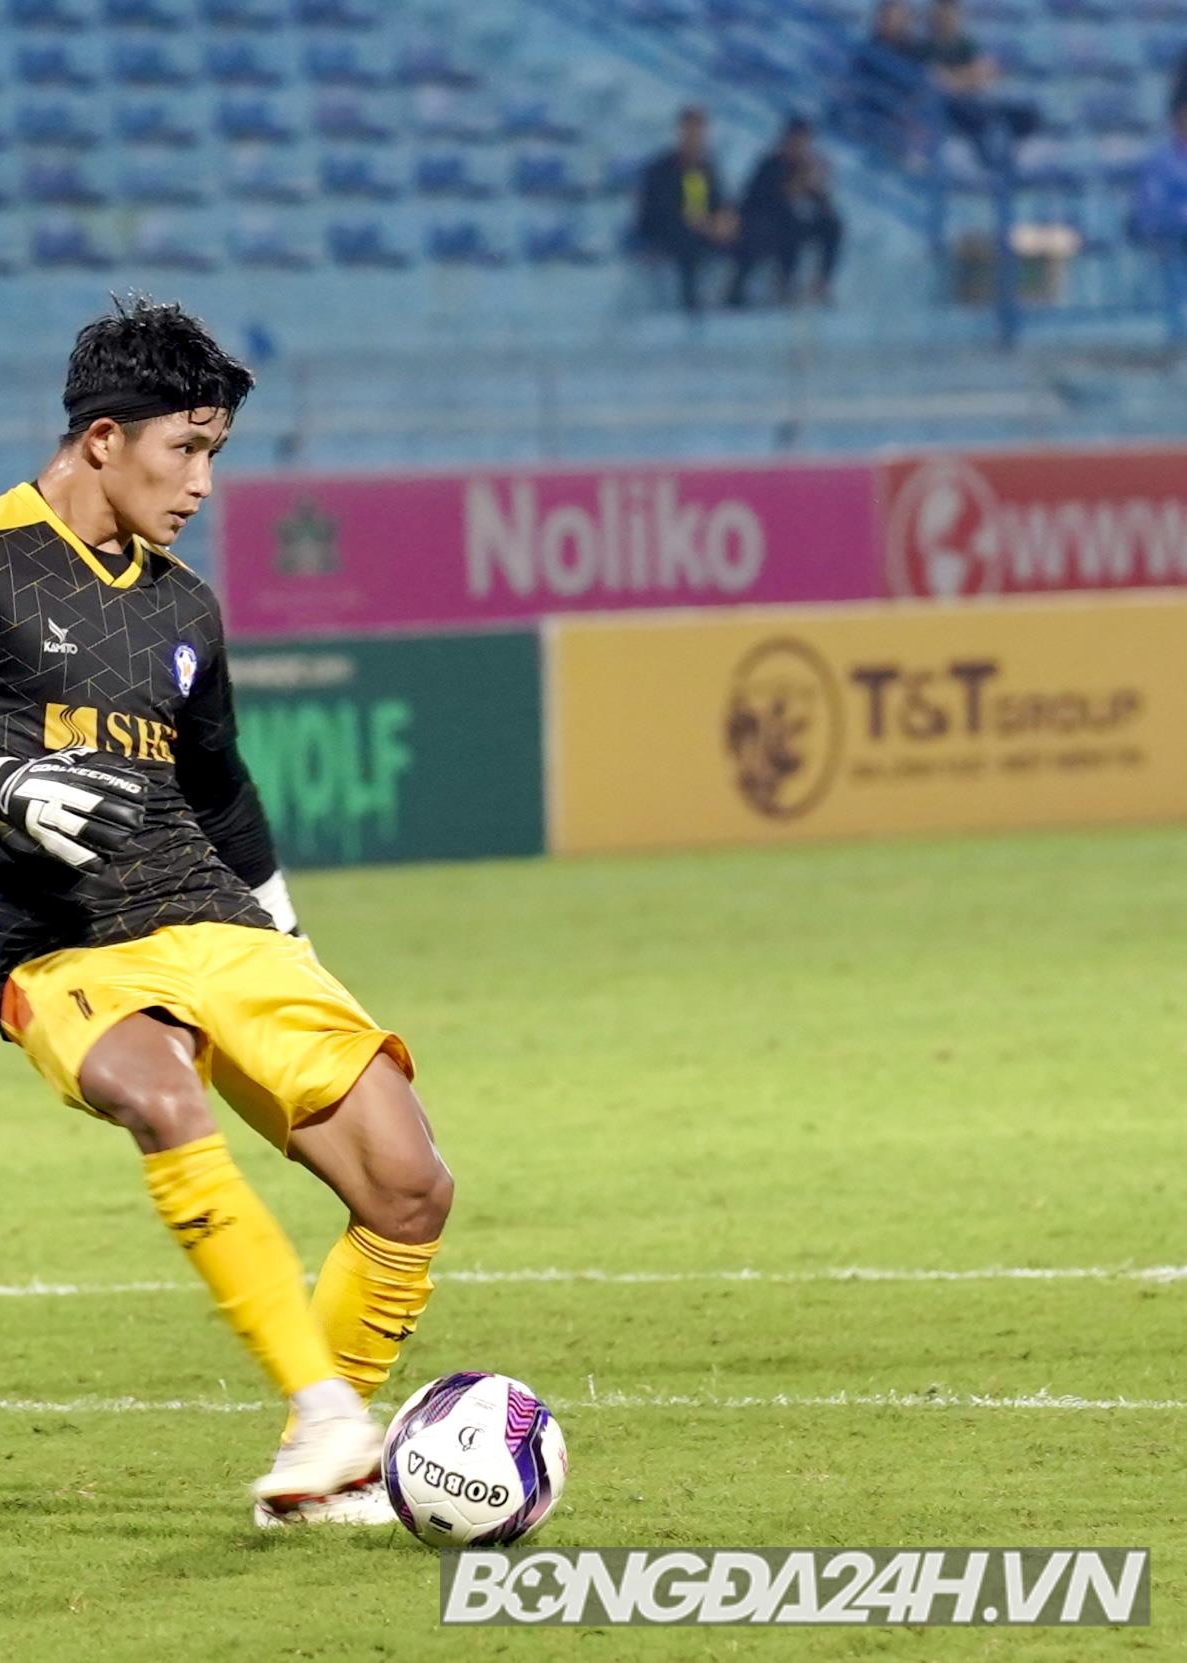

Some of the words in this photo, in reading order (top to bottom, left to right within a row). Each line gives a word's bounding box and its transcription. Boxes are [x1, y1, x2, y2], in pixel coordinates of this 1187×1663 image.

[464, 476, 766, 600] Noliko
[850, 656, 998, 741] T&T
[29, 762, 143, 795] GOALKEEPING
[407, 1451, 510, 1508] COBRA
